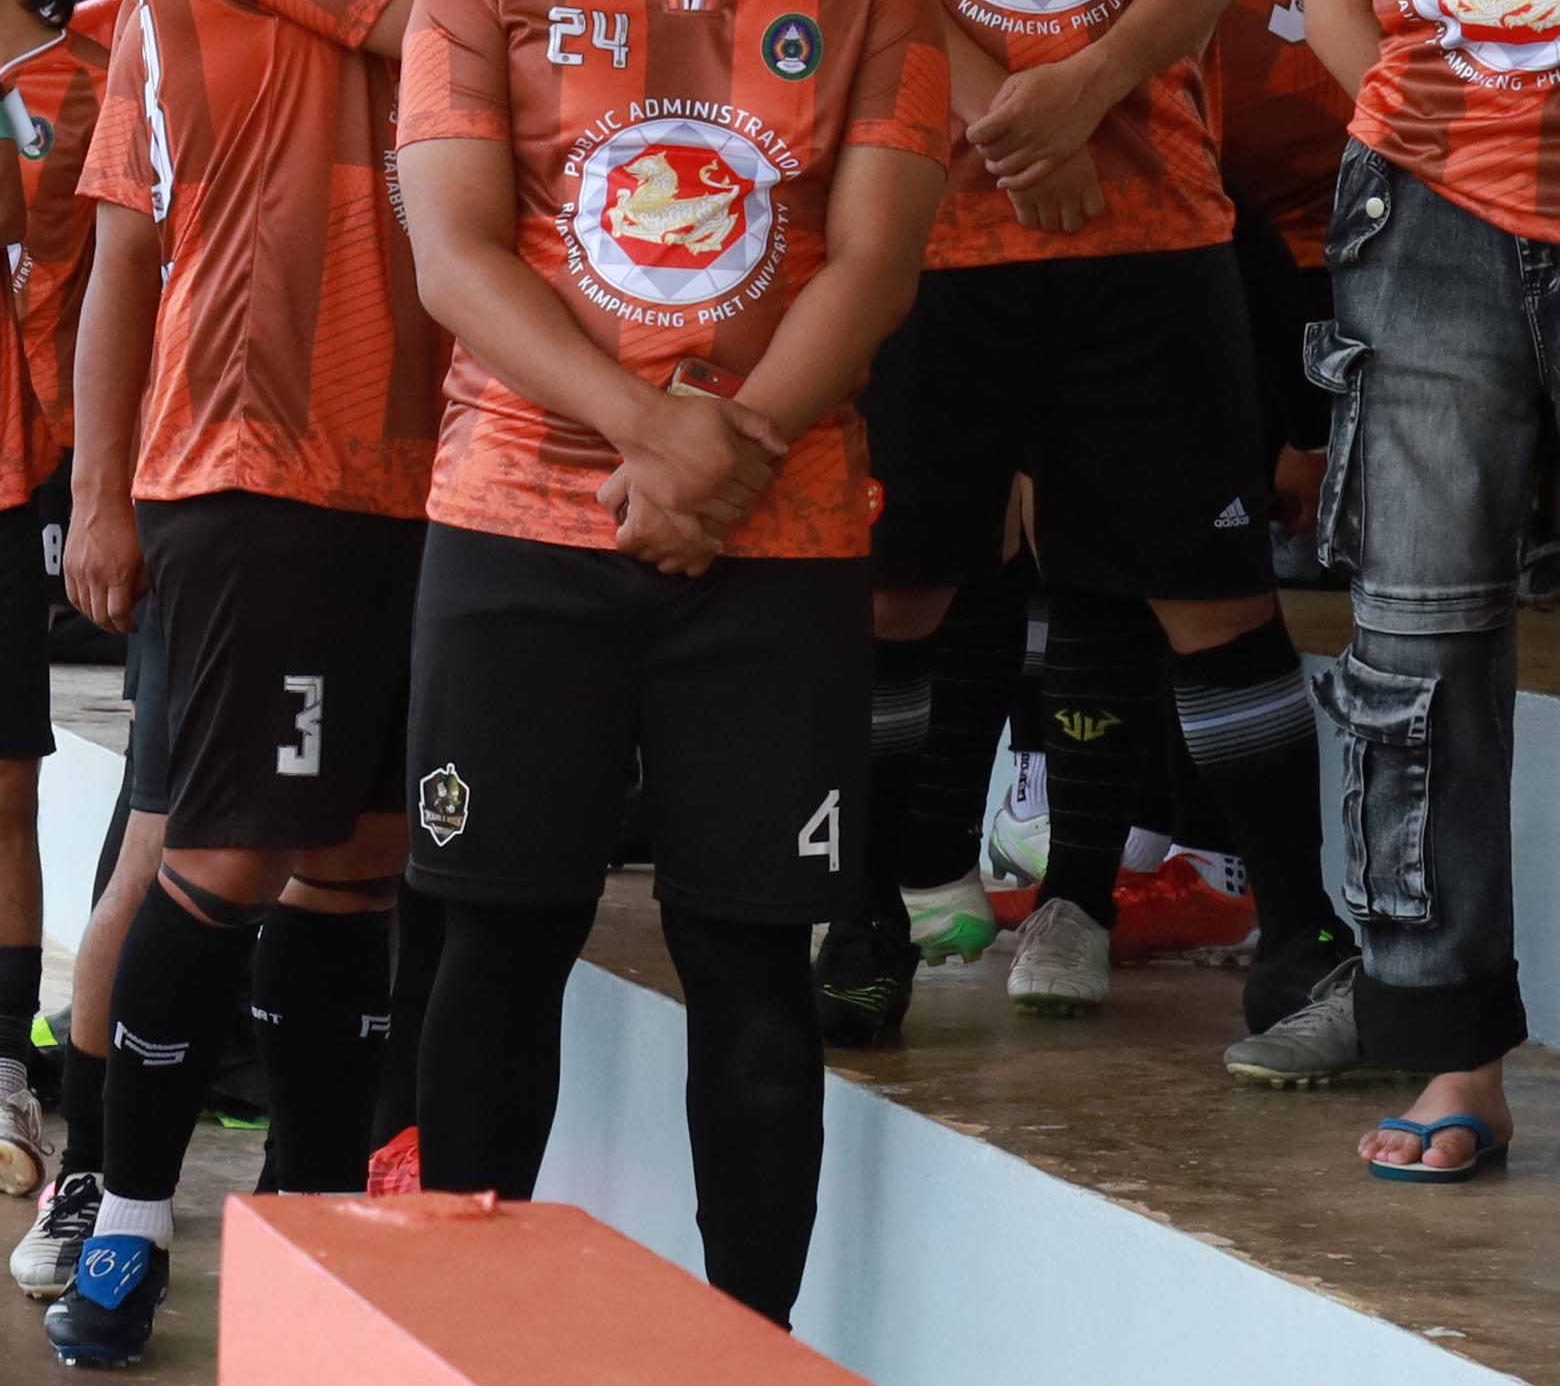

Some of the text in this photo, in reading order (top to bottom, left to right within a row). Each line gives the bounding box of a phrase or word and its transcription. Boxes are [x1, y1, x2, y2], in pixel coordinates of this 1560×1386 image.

[547, 6, 629, 68] 24
[1072, 3, 1108, 29] PHET
[564, 98, 802, 182] PUBLIC ADMINISTRATION
[578, 275, 685, 327] KAMPHAENG
[698, 297, 745, 323] PHET
[749, 203, 789, 299] UNIVERSITY
[1214, 515, 1249, 527] adidas
[277, 675, 324, 776] 3
[798, 789, 840, 872] 4
